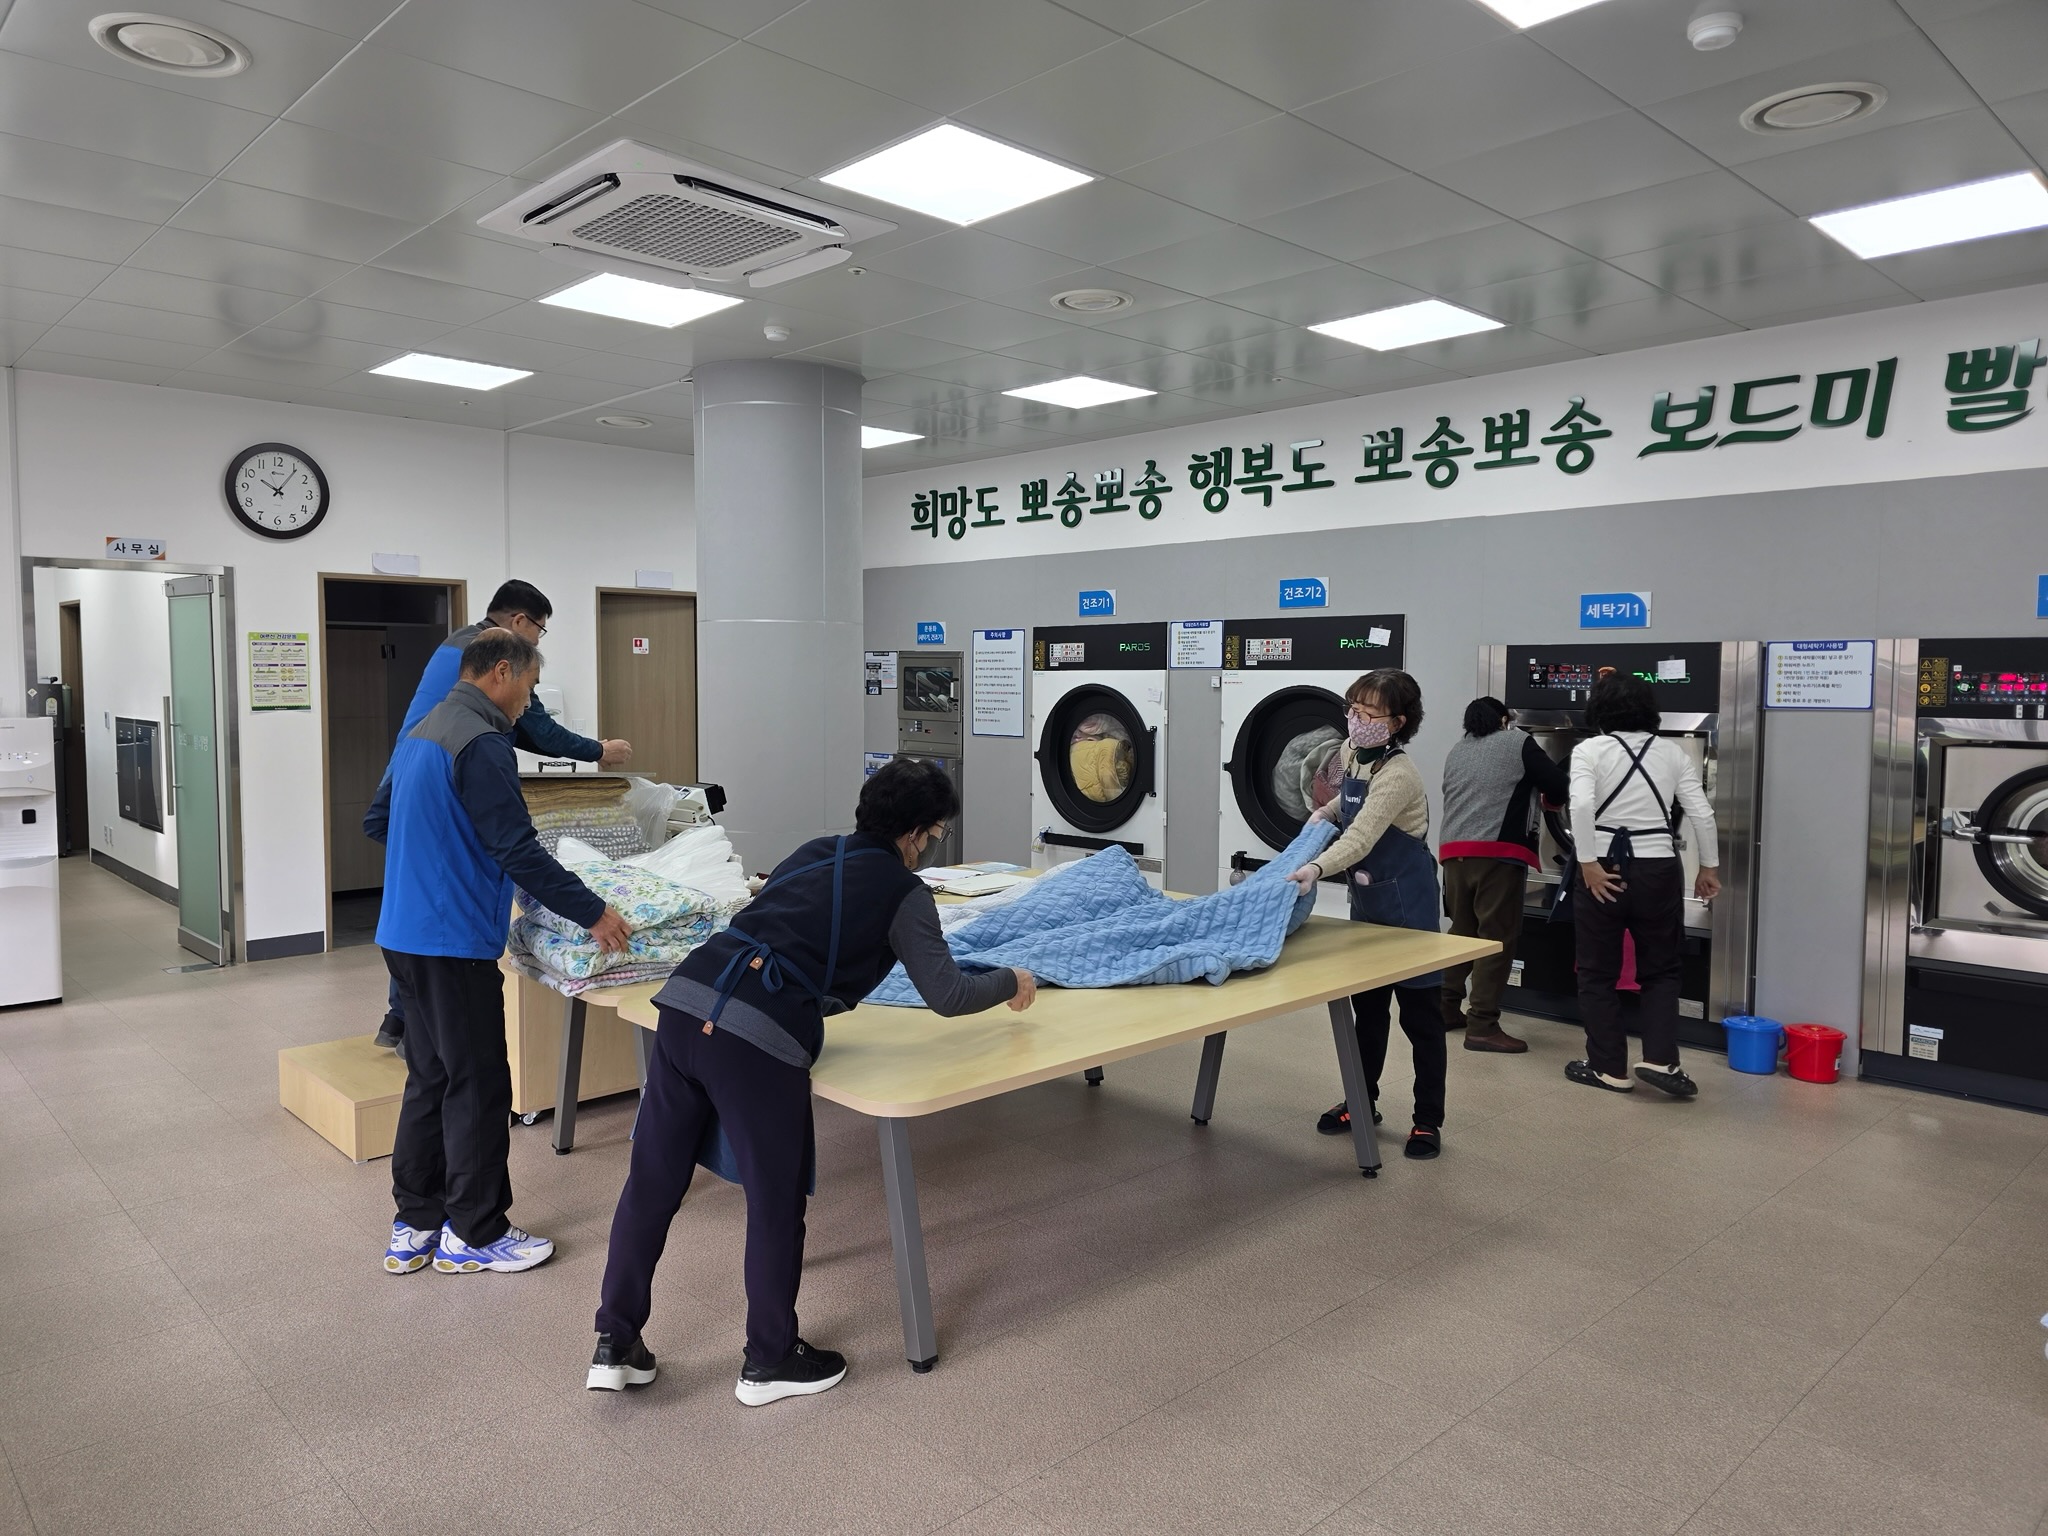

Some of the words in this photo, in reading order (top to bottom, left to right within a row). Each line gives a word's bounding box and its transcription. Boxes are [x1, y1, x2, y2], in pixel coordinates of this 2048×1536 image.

[910, 485, 1006, 540] 희망도
[1016, 459, 1173, 529] 뽀송뽀송
[1187, 439, 1336, 513] 행복도
[1354, 395, 1613, 488] 뽀송뽀송
[1636, 356, 1899, 459] 보드미
[1944, 337, 2048, 435] 빨
[258, 458, 265, 470] 11
[273, 456, 284, 467] 12
[244, 467, 256, 479] 10
[301, 474, 309, 485] 2
[241, 482, 250, 492] 9
[305, 489, 313, 500] 3
[244, 497, 253, 507] 8
[300, 504, 308, 514] 4
[257, 510, 264, 521] 7
[273, 515, 282, 525] 6
[288, 513, 297, 523] 5
[113, 542, 160, 555] 사무실
[1283, 585, 1322, 601] 건조기2
[1082, 597, 1110, 610] 건조기1
[1586, 602, 1640, 619] 세탁기1
[1119, 642, 1151, 652] PAROS
[1796, 642, 1825, 650] 대형세탁기
[1826, 642, 1844, 650] 사용법
